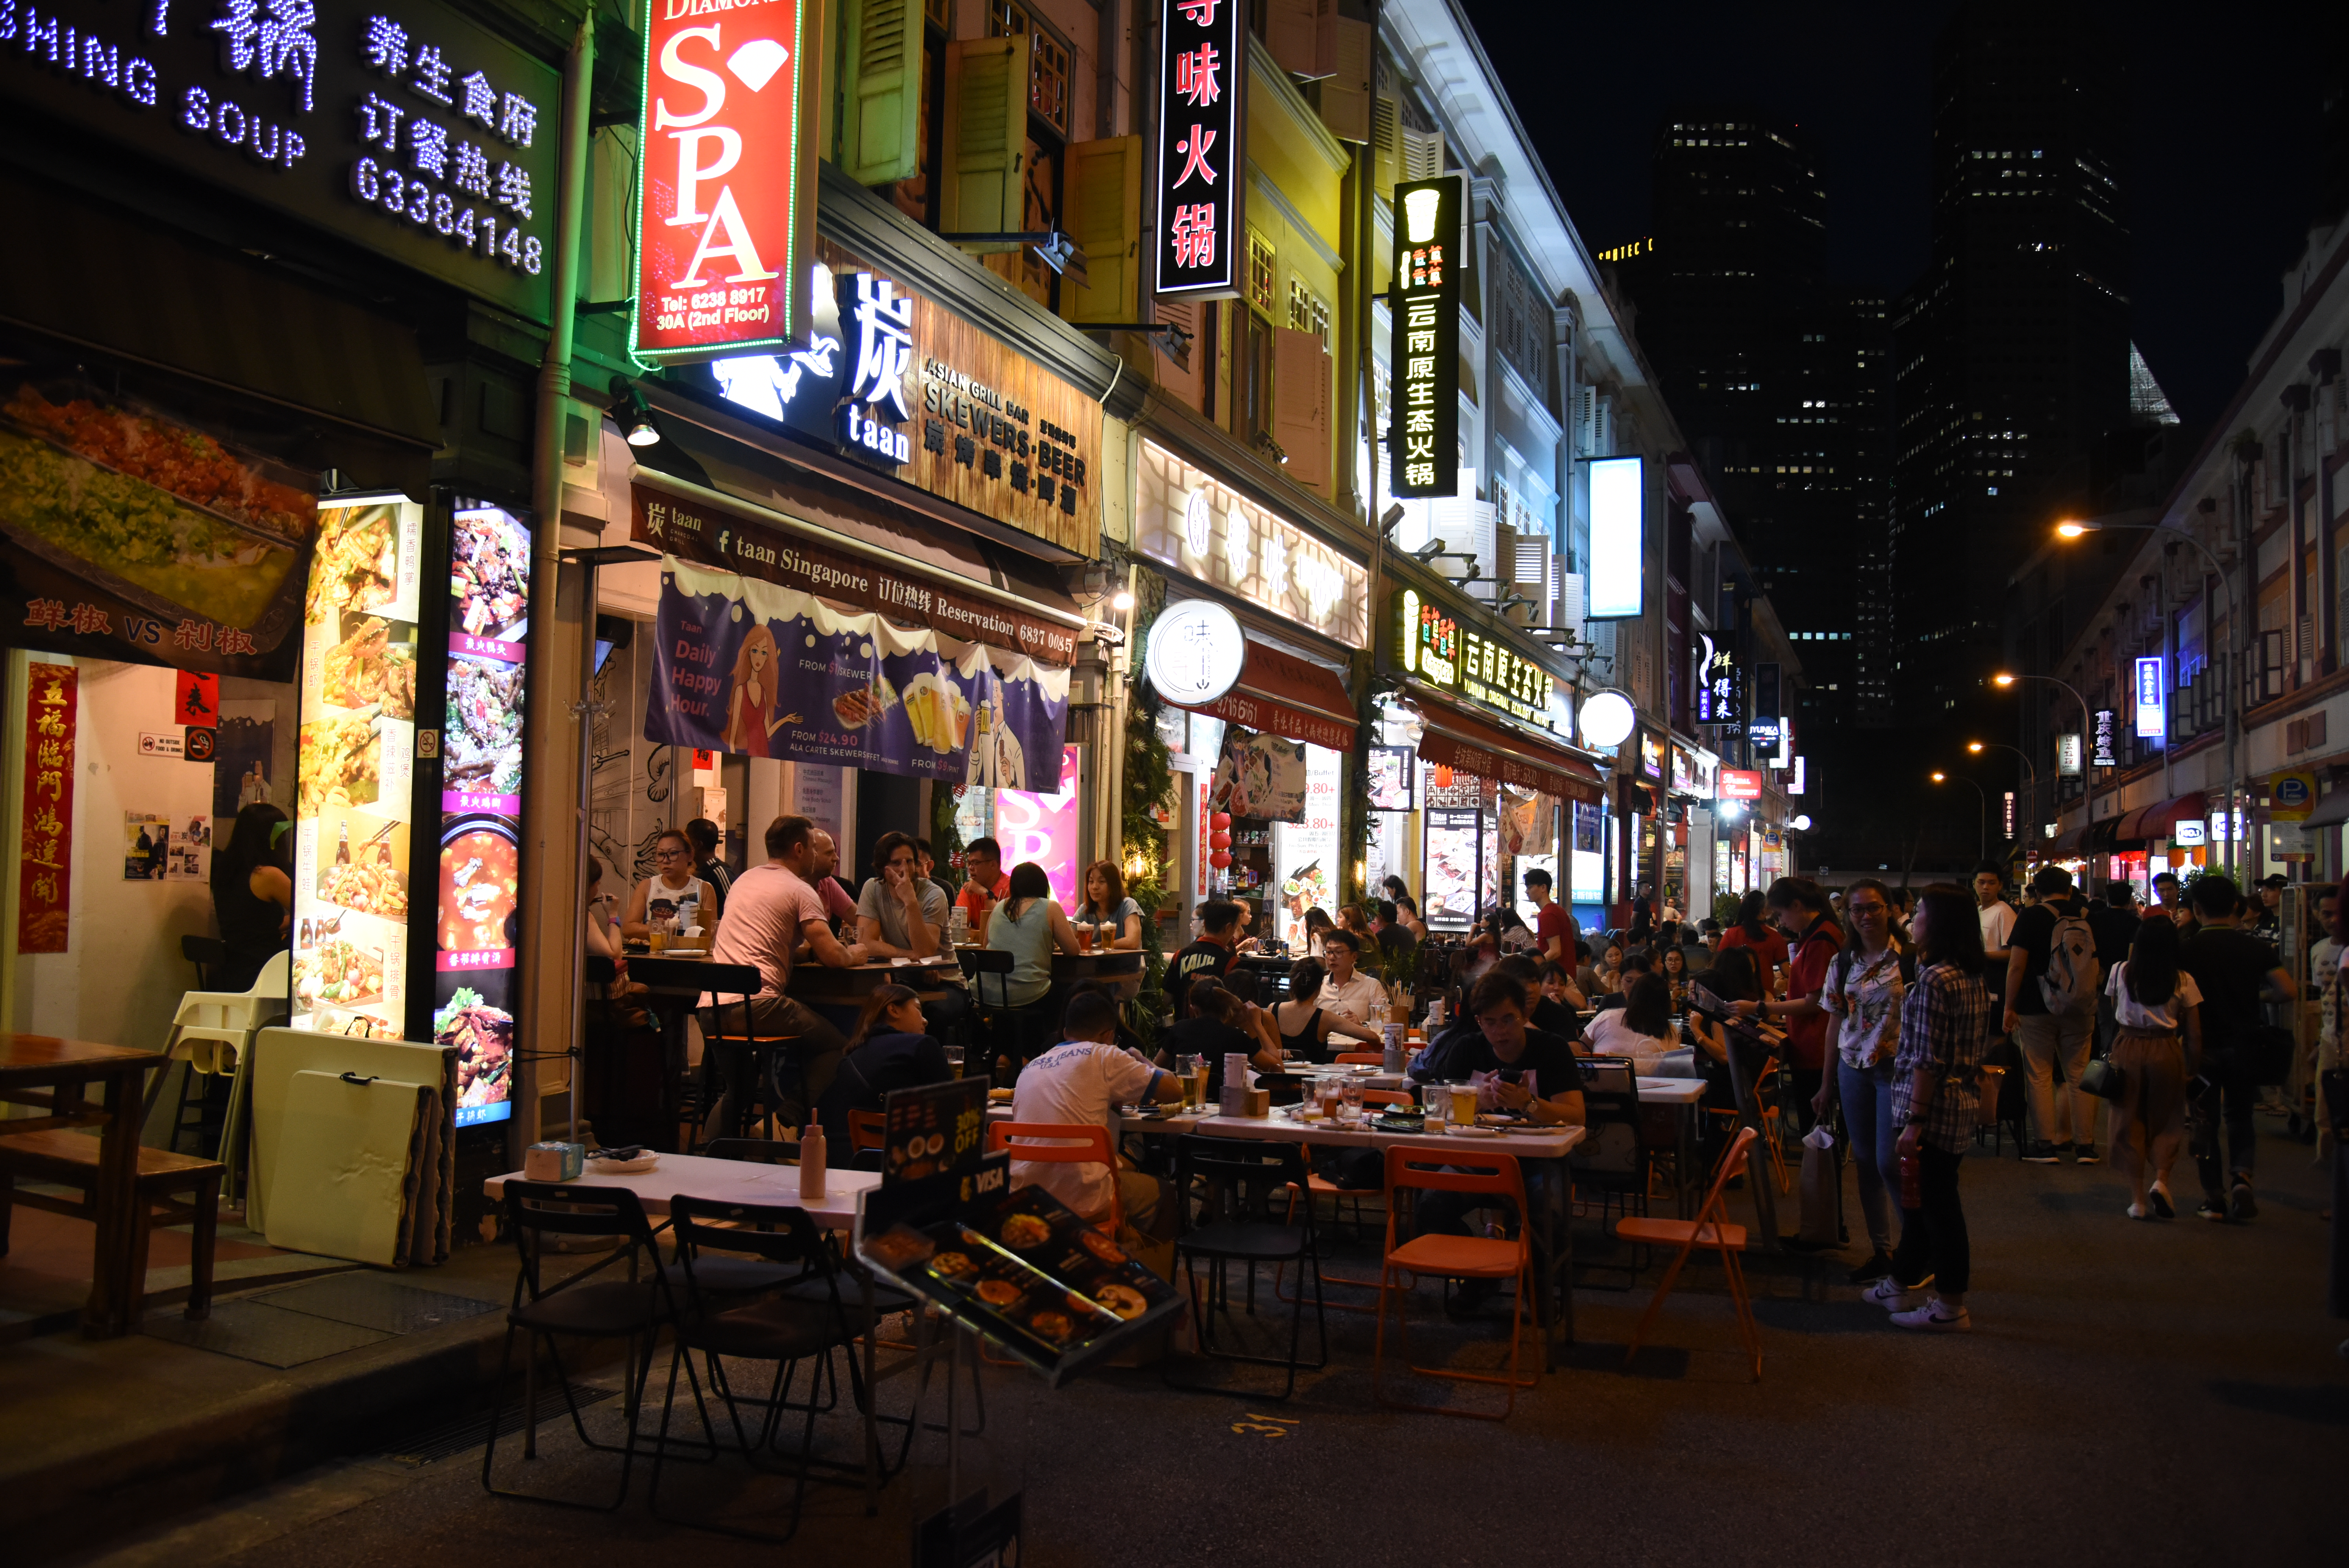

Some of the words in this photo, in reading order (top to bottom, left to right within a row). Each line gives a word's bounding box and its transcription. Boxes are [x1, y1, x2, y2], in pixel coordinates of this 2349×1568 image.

[365, 15, 538, 148] 养生食府
[184, 86, 306, 169] SOUP
[359, 91, 533, 221] 订餐热线
[655, 23, 779, 290] SPA
[353, 156, 542, 276] 63384148
[661, 296, 688, 313] Tel:
[691, 290, 726, 309] 6238
[729, 287, 766, 306] 8917
[656, 314, 685, 331] 30A
[688, 308, 721, 331] (2nd
[724, 304, 769, 325] Floor)
[852, 273, 912, 422] 炭
[927, 358, 967, 391] ASIAN
[971, 382, 1003, 411] GRILL
[1007, 400, 1030, 425] BAR
[1406, 303, 1435, 486] 云南原生态火锅
[848, 403, 910, 465] taan
[647, 502, 666, 538] 炭
[672, 507, 702, 531] taan
[669, 536, 685, 545] GRILL
[670, 529, 699, 542] CHARCOAL
[404, 521, 417, 586] 糯香鸭掌
[736, 535, 776, 566] taan
[781, 548, 868, 593] Singapore
[878, 575, 932, 614] 订位热线
[24, 597, 113, 635] 鲜椒
[125, 617, 162, 644] VS
[174, 618, 258, 656] 剁椒
[680, 620, 703, 635] Taan
[937, 597, 1014, 637] Reservation
[1020, 624, 1045, 647] 6837
[1048, 633, 1073, 653] 0085
[308, 641, 320, 688] 干锅虾
[675, 640, 716, 669] Daily
[799, 659, 826, 673] FROM
[671, 666, 722, 697] Happy
[1467, 633, 1554, 712] 云南原生态火锅
[1711, 650, 1733, 720] 鲜得来
[669, 692, 710, 718] Hour.
[1464, 678, 1486, 700] YUNNAN
[1488, 690, 1509, 711] ORIGINAL
[1511, 701, 1531, 720] ECOLOGY
[1533, 711, 1550, 729] HOTPOT
[1700, 690, 1709, 720] 有料火锅
[791, 730, 816, 743] FROM
[819, 730, 858, 747] $24.90
[1749, 726, 1778, 734] JYUNKA
[2095, 711, 2113, 758] 重庆烤鱼
[385, 729, 397, 791] 香辣滋补
[399, 746, 411, 778] 鸡煲
[790, 743, 803, 752] ALA
[805, 744, 828, 755] CARTE
[829, 748, 866, 759] SKEWERS
[911, 759, 936, 770] FROM
[937, 758, 959, 774] $9/PINT
[1453, 744, 1492, 775] 全球第60家分店
[2064, 736, 2073, 764] 日本料理
[1725, 784, 1758, 796] CONCEPT
[2283, 780, 2302, 799] P
[2180, 828, 2201, 837] NO.1
[302, 828, 312, 891] 干锅牛蛙
[389, 935, 401, 999] 干锅排骨
[1054, 1048, 1092, 1062] JEANS
[954, 1127, 979, 1154] OFF
[975, 1167, 1004, 1194] VISA
